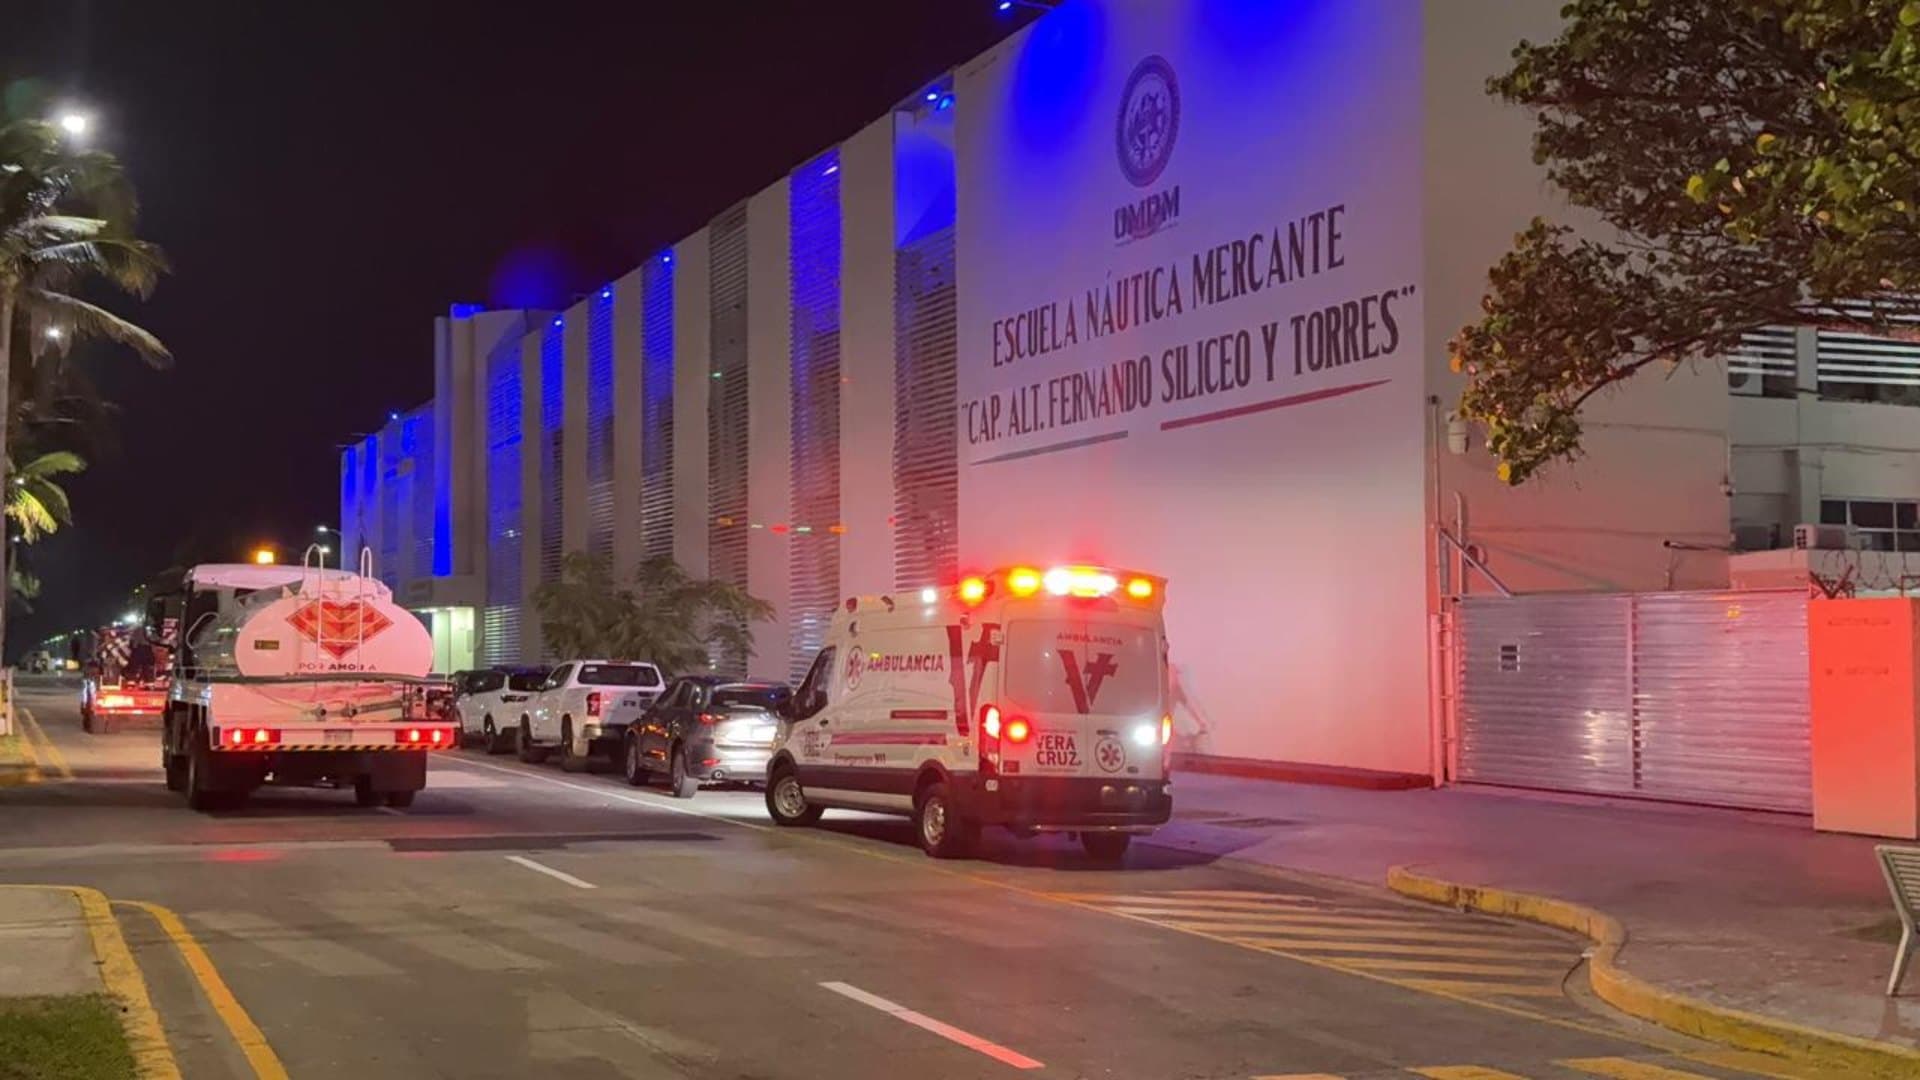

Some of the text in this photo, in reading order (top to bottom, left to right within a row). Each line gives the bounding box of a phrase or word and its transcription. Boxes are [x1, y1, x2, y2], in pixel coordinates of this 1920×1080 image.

[993, 204, 1345, 368] ESCUELA NÁUTICA MERCANTE
[1008, 384, 1045, 437] ALT.
[1048, 356, 1152, 428] FERNANDO
[1161, 329, 1251, 404] SILICEO
[1261, 322, 1279, 382] Y
[1057, 632, 1123, 645] AMBULANCIA
[867, 653, 945, 672] AMBULANCIA
[1036, 735, 1076, 750] VERA
[1036, 751, 1078, 766] CRUZ
